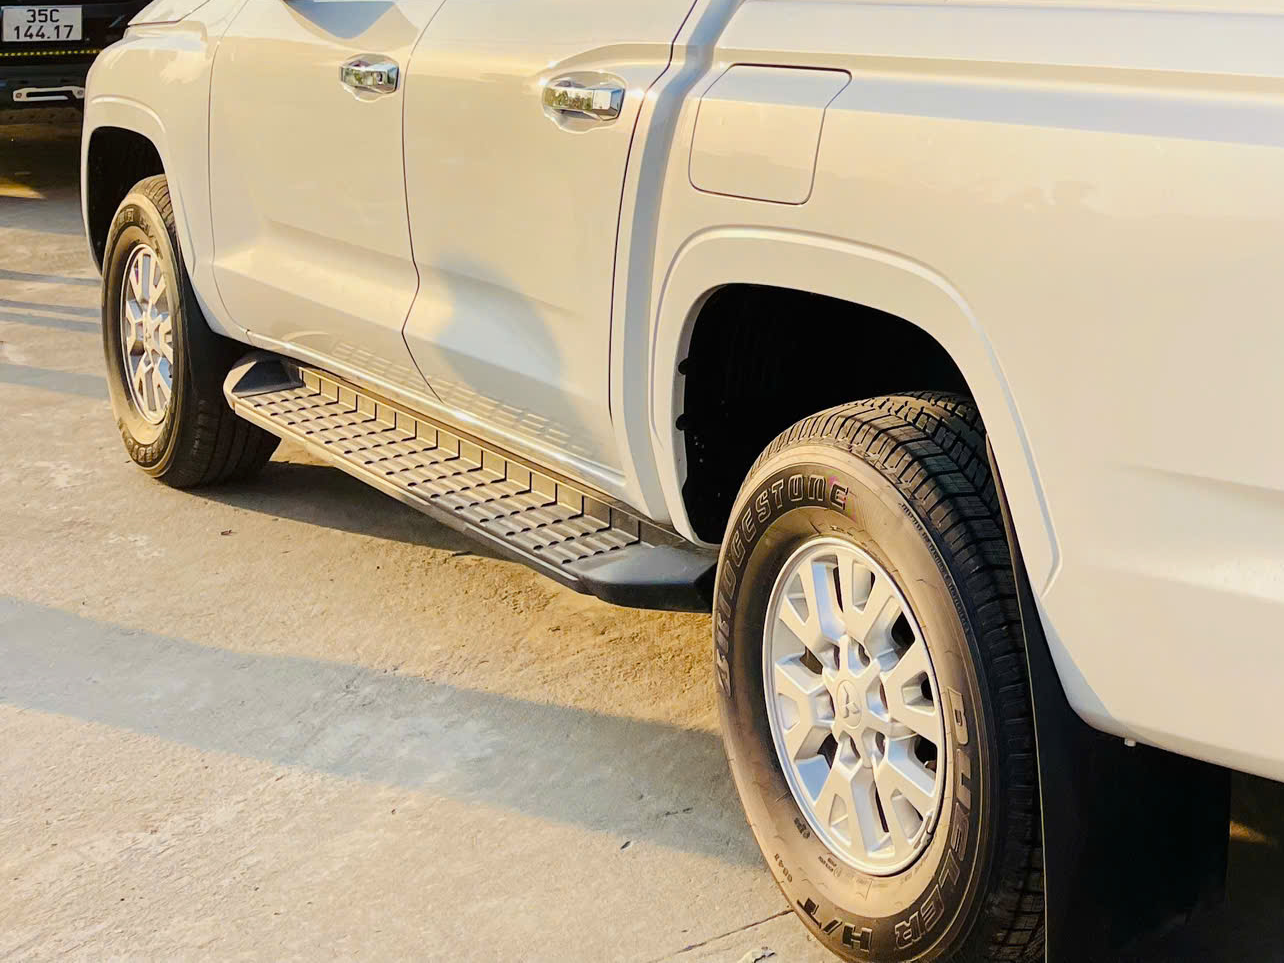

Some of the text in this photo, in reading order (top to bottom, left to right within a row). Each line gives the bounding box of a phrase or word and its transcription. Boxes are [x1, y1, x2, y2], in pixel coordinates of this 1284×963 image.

[14, 24, 74, 40] 144.17
[26, 8, 60, 23] 35C
[714, 473, 849, 699] BRIDGESTONE
[796, 897, 872, 953] H/T
